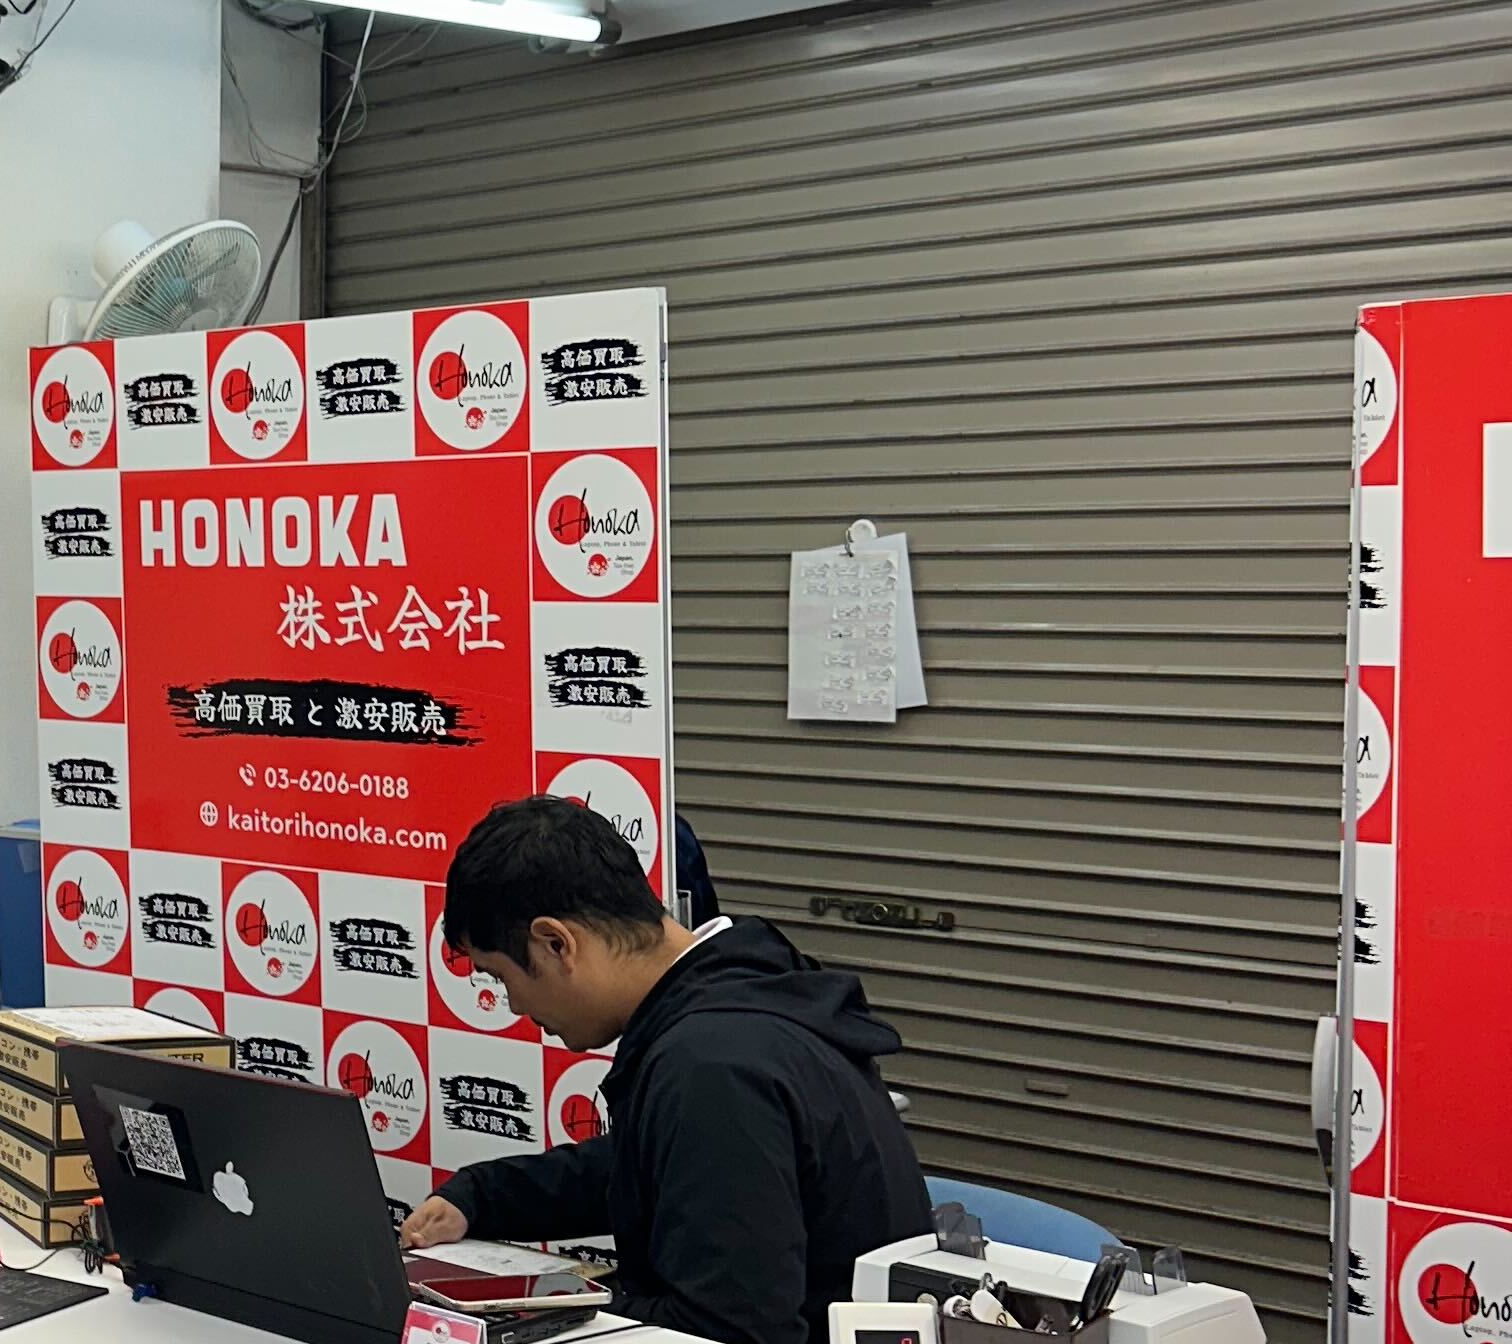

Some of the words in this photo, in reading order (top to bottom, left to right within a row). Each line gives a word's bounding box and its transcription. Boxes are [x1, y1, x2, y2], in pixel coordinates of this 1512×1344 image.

[561, 347, 625, 368] 高価買取
[332, 366, 387, 385] 高価買取
[435, 344, 513, 407] Honoka
[563, 377, 628, 398] 激安販売
[335, 394, 390, 412] 激安販売
[139, 493, 407, 568] HONOKA
[554, 488, 640, 553] Honoka
[276, 584, 505, 655] 株式会社
[564, 654, 628, 674] 高価買取
[567, 683, 632, 704] 激安販売
[193, 689, 295, 726] 高価買取
[307, 699, 323, 725] と
[335, 697, 447, 736] 激安販売
[264, 766, 409, 799] 03-6206-0188
[227, 806, 448, 851] kaitorihonoka.com
[457, 1080, 515, 1106] 高価買取
[460, 1109, 519, 1137] 激安販売
